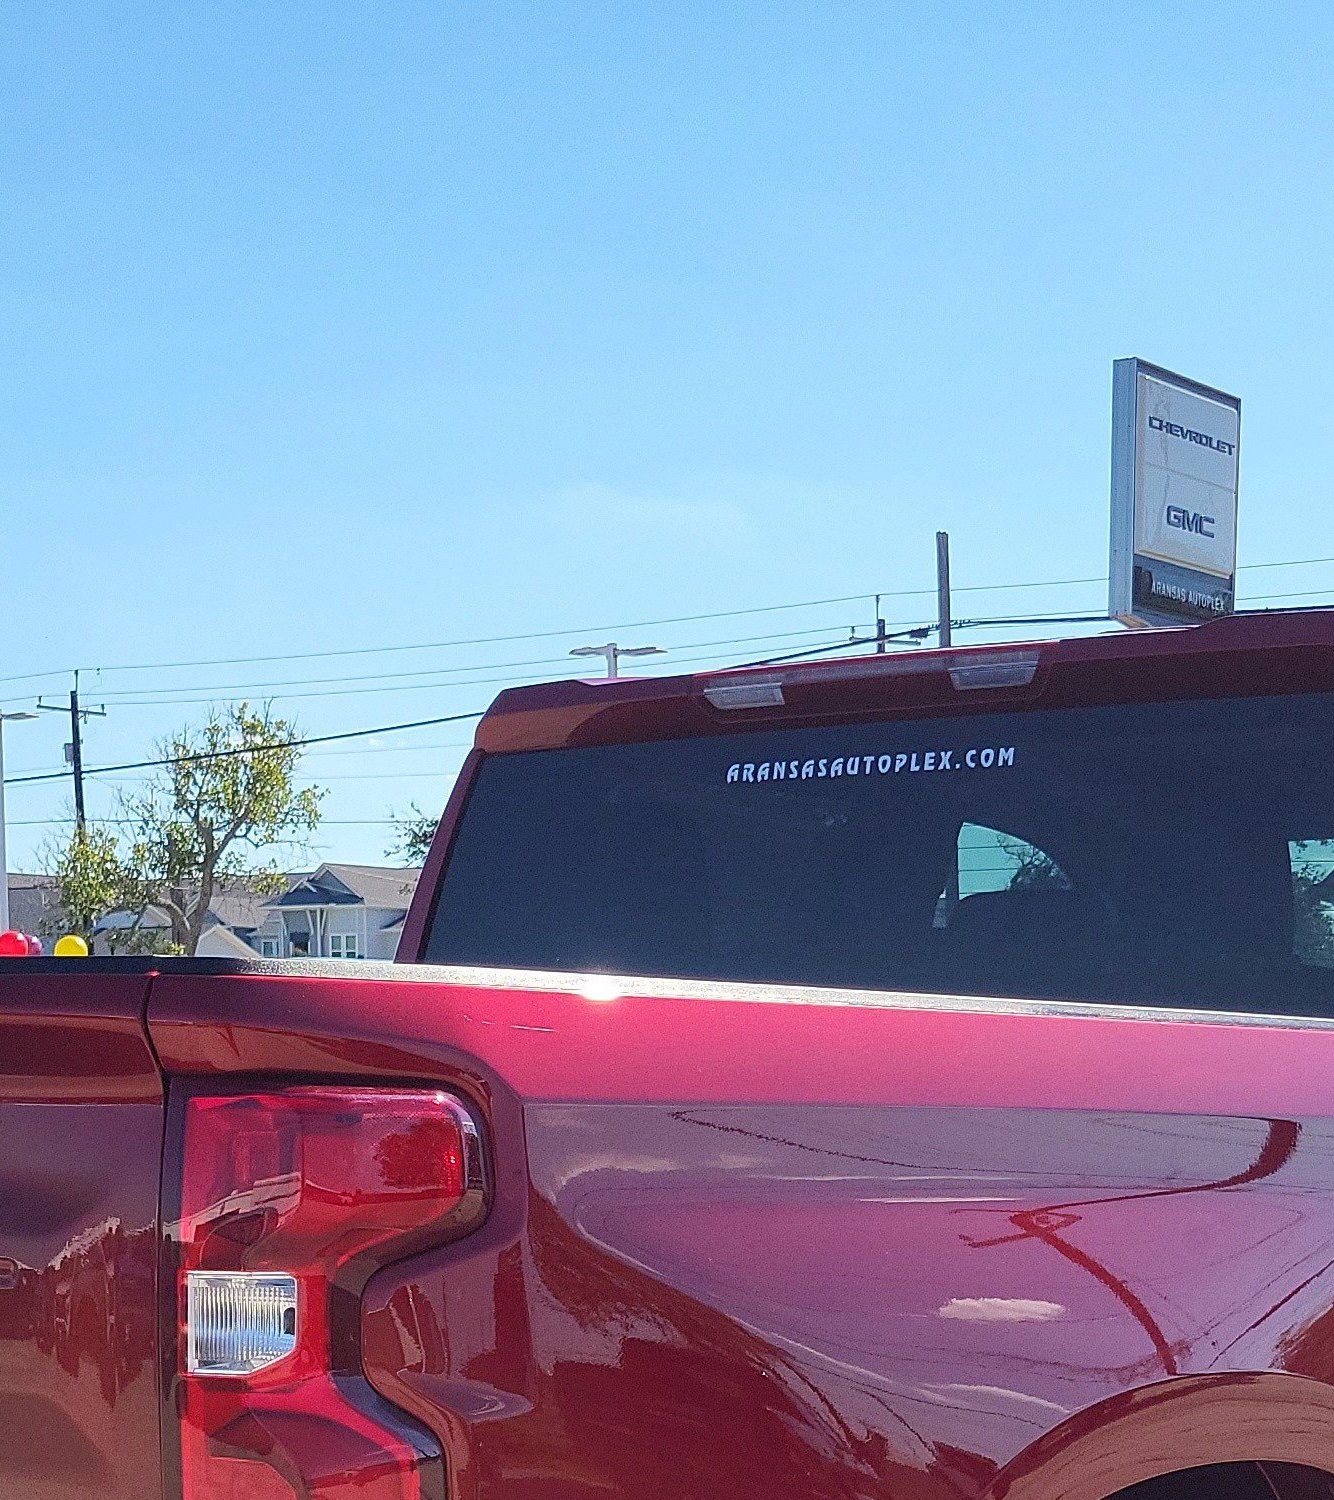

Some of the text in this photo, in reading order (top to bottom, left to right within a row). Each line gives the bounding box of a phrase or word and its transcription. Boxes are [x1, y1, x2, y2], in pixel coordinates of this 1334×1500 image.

[1148, 415, 1235, 456] CHEVROLET
[1167, 504, 1215, 538] GMC
[1151, 580, 1225, 611] ARANSAS AUTOPLEX
[726, 747, 1015, 783] ARANSASAUTOPLEX.COM
